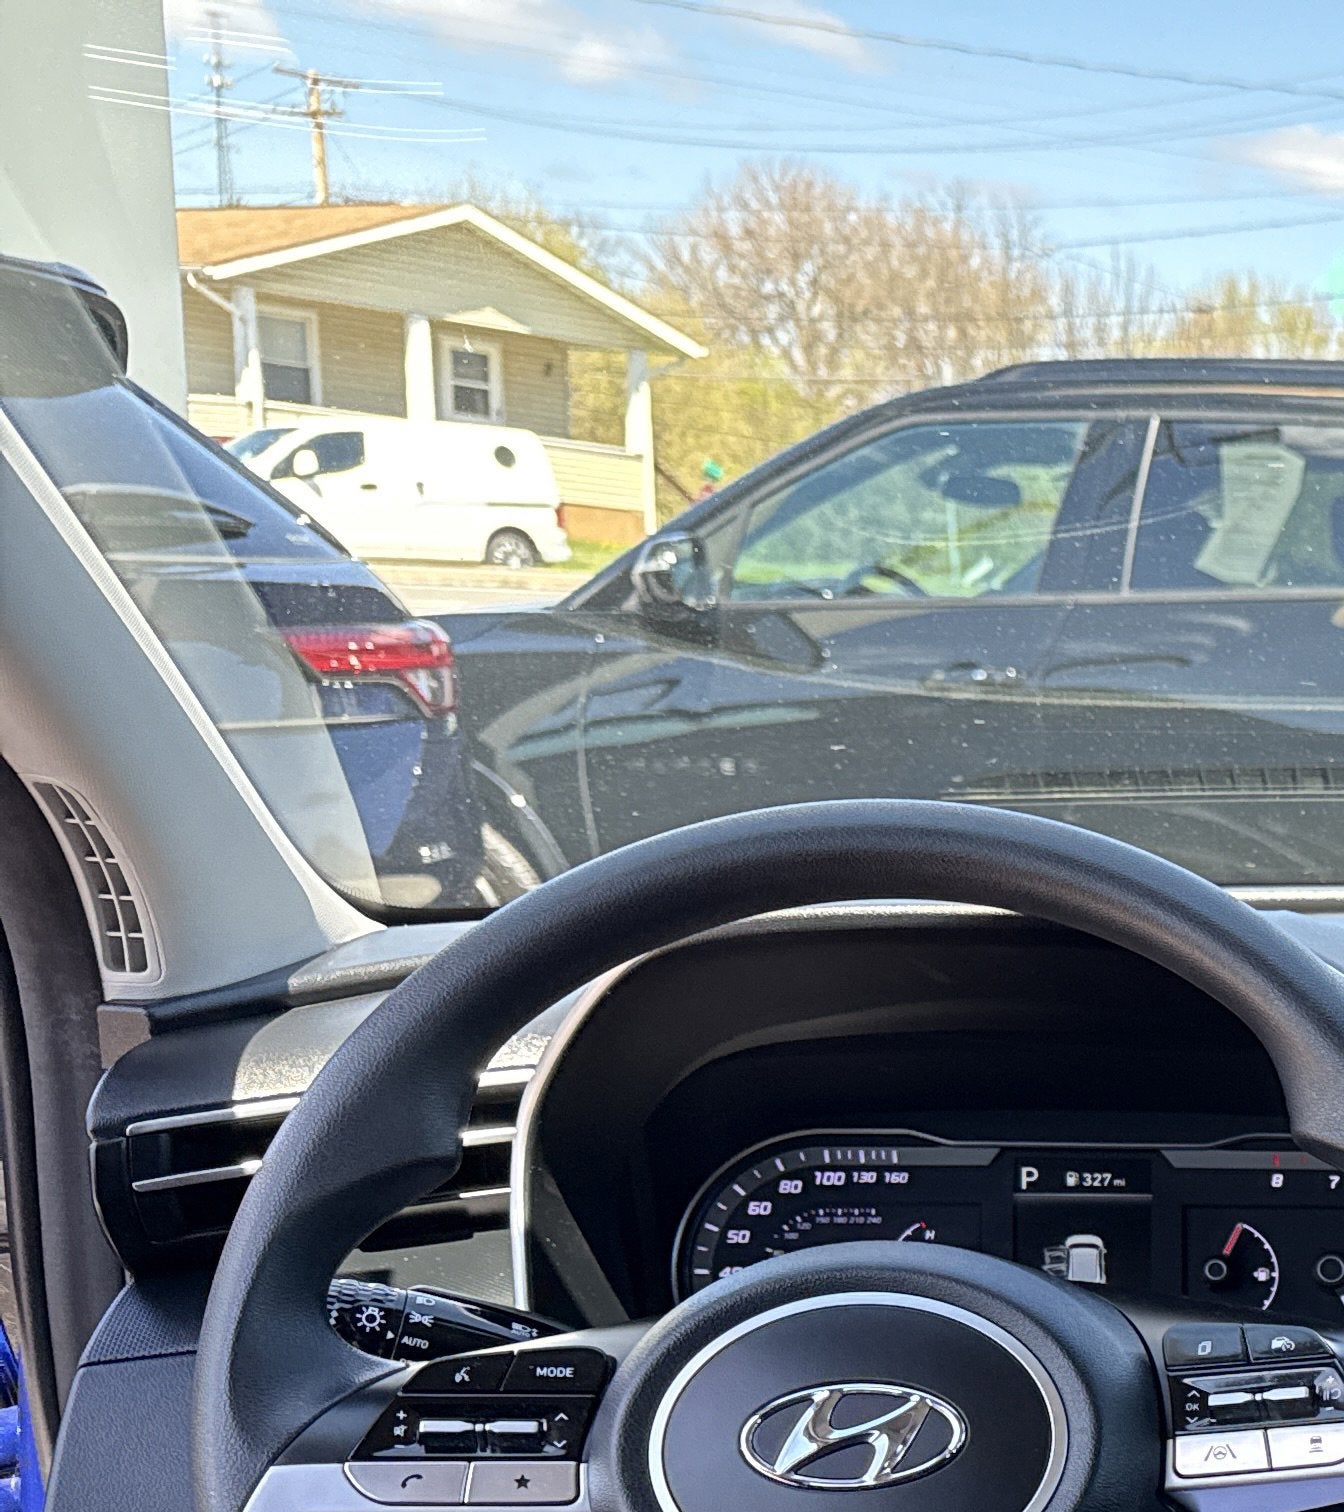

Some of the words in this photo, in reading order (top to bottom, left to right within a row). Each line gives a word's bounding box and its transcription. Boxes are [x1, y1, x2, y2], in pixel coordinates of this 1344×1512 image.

[814, 1171, 846, 1186] 100
[852, 1171, 877, 1184] 130
[884, 1172, 909, 1184] 160
[1021, 1167, 1038, 1189] P
[1082, 1173, 1112, 1187] 327
[1113, 1176, 1126, 1187] mi
[1271, 1173, 1284, 1188] 8
[1329, 1176, 1340, 1189] 7
[778, 1180, 803, 1194] 80
[747, 1201, 772, 1215] 60
[726, 1229, 751, 1244] 50
[925, 1230, 935, 1240] H
[401, 1336, 429, 1349] AUTO
[536, 1367, 574, 1378] MODE
[1185, 1403, 1199, 1411] OK
